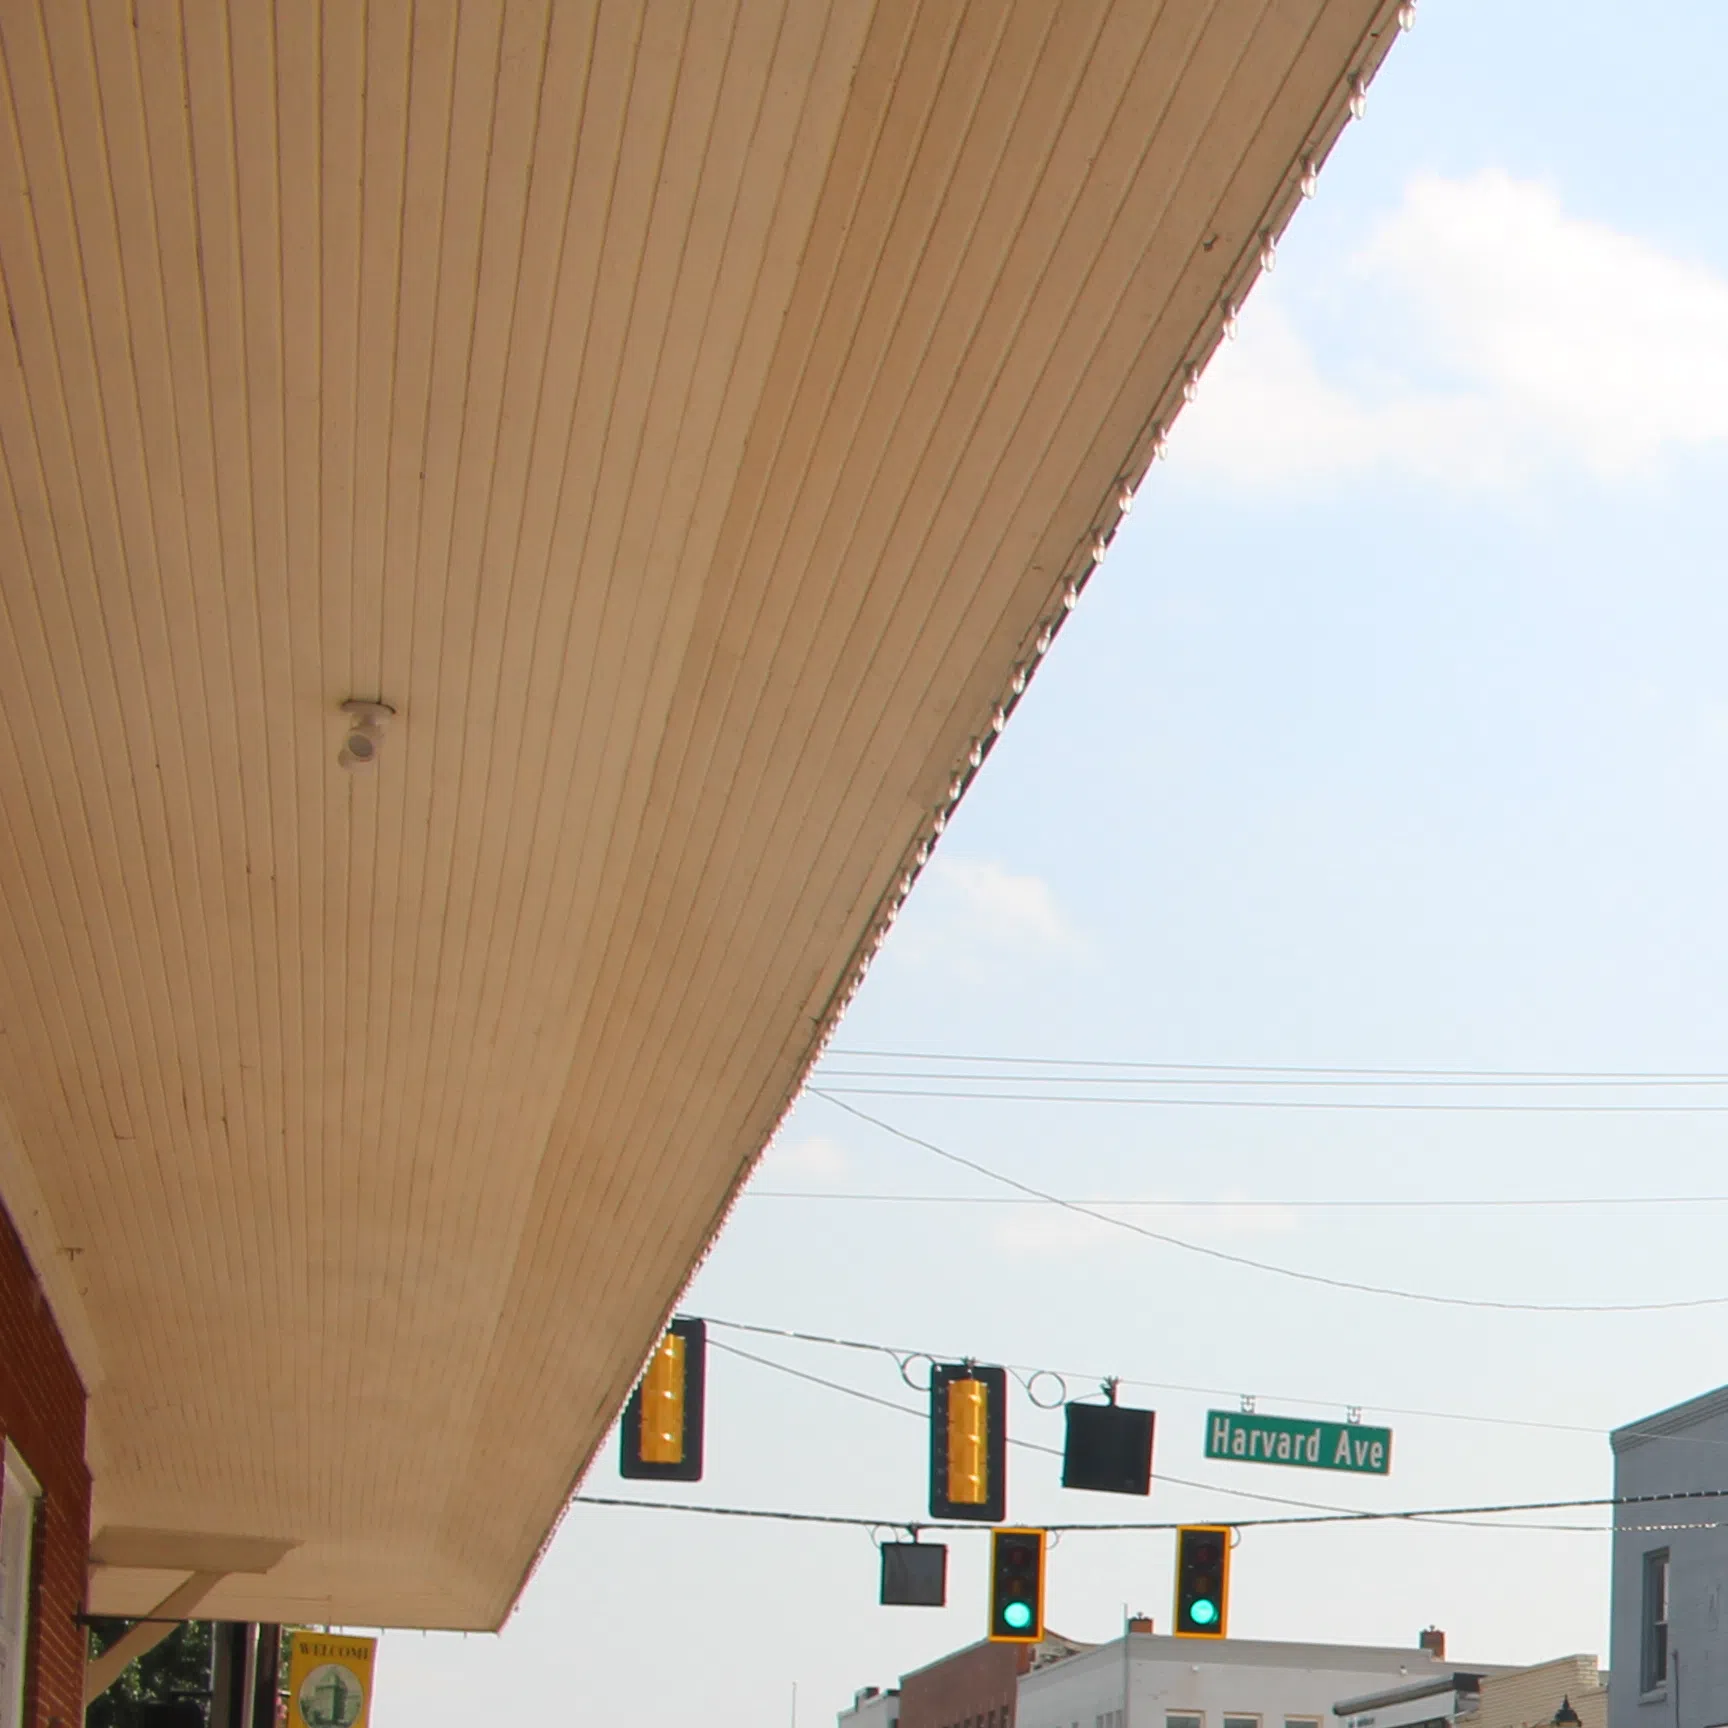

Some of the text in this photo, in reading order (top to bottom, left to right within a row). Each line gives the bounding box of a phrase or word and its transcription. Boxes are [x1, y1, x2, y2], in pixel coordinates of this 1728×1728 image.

[1212, 1417, 1384, 1469] Harvard Ave
[300, 1643, 369, 1660] WELCOME
